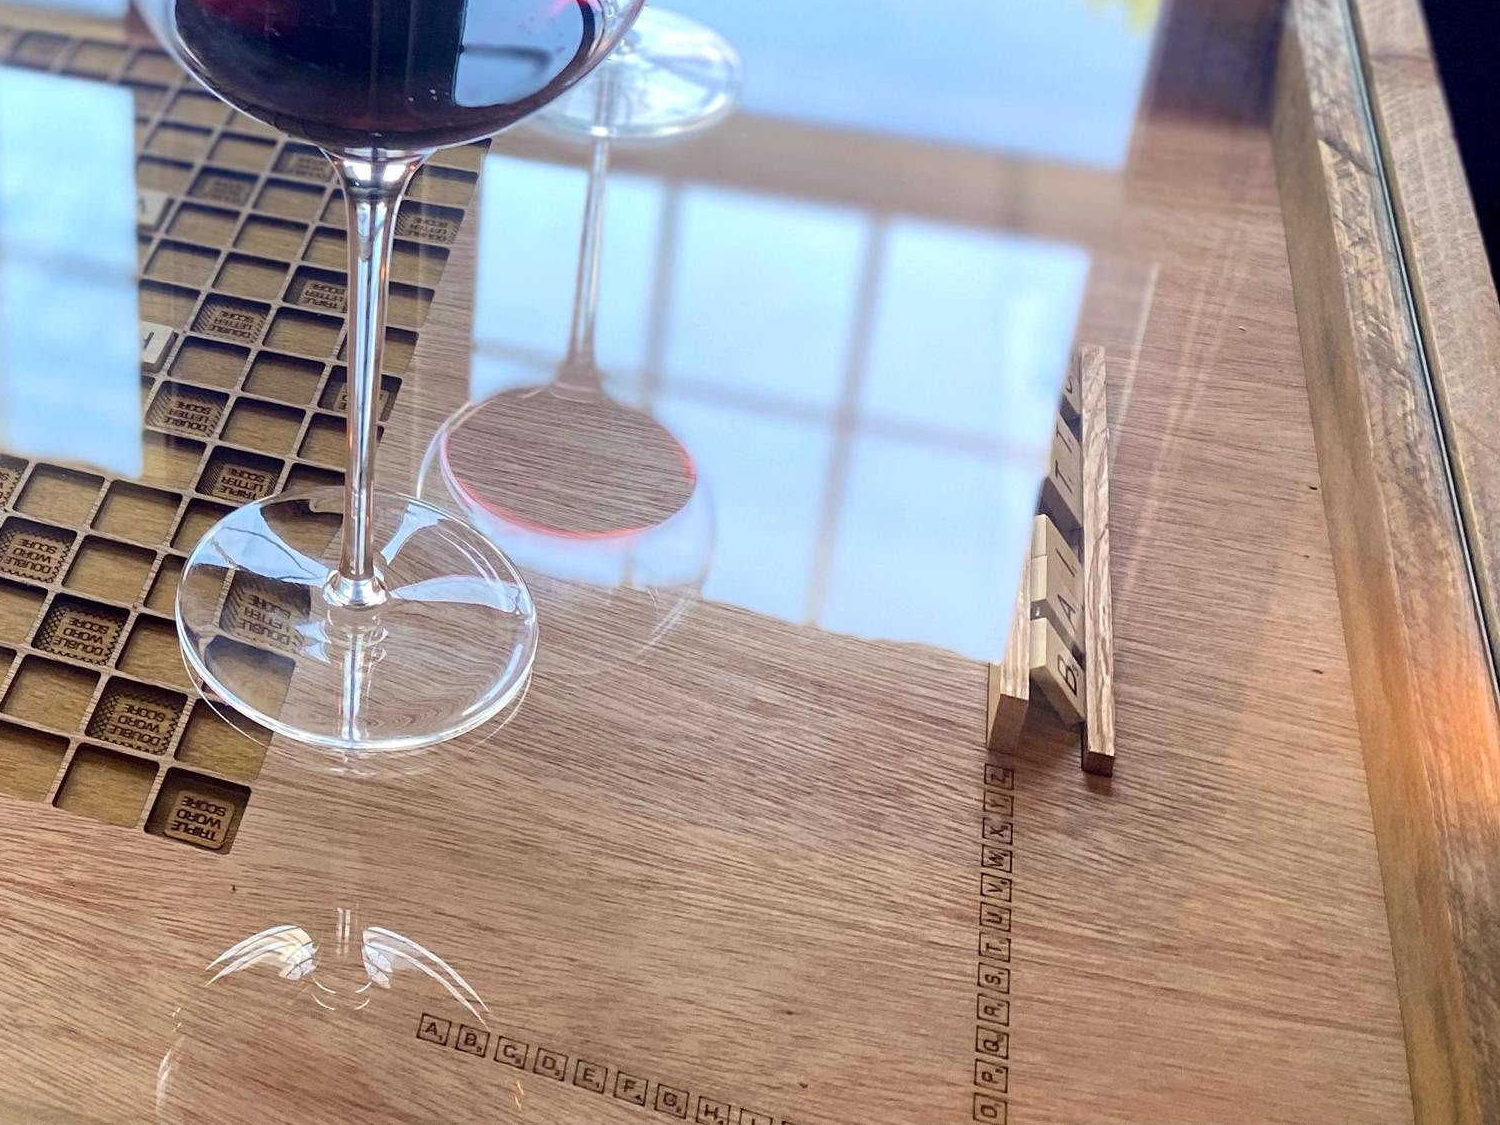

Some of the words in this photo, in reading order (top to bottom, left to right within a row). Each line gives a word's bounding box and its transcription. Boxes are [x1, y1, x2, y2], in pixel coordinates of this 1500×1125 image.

[212, 317, 252, 330] LETTER
[218, 310, 254, 323] SCORE
[206, 323, 251, 338] DOUBLE
[167, 408, 208, 423] LETTER
[174, 400, 211, 414] SCORE
[160, 415, 208, 432] DOUBLE
[220, 475, 263, 491] LETTER
[225, 467, 266, 482] SCORE
[217, 484, 258, 500] TRIPLE
[16, 537, 58, 554] SCORE
[10, 546, 53, 563] WORD
[2, 555, 52, 574] DOUBLE
[65, 616, 110, 634] SCORE
[60, 626, 105, 644] WORD
[50, 635, 104, 656] DOUBLE
[120, 702, 166, 722] SCORE
[115, 713, 162, 733] WORD
[106, 723, 161, 745] DOUBLE
[180, 795, 228, 816] SCORE
[174, 807, 223, 829] WORD
[169, 819, 218, 841] TRIPLE
